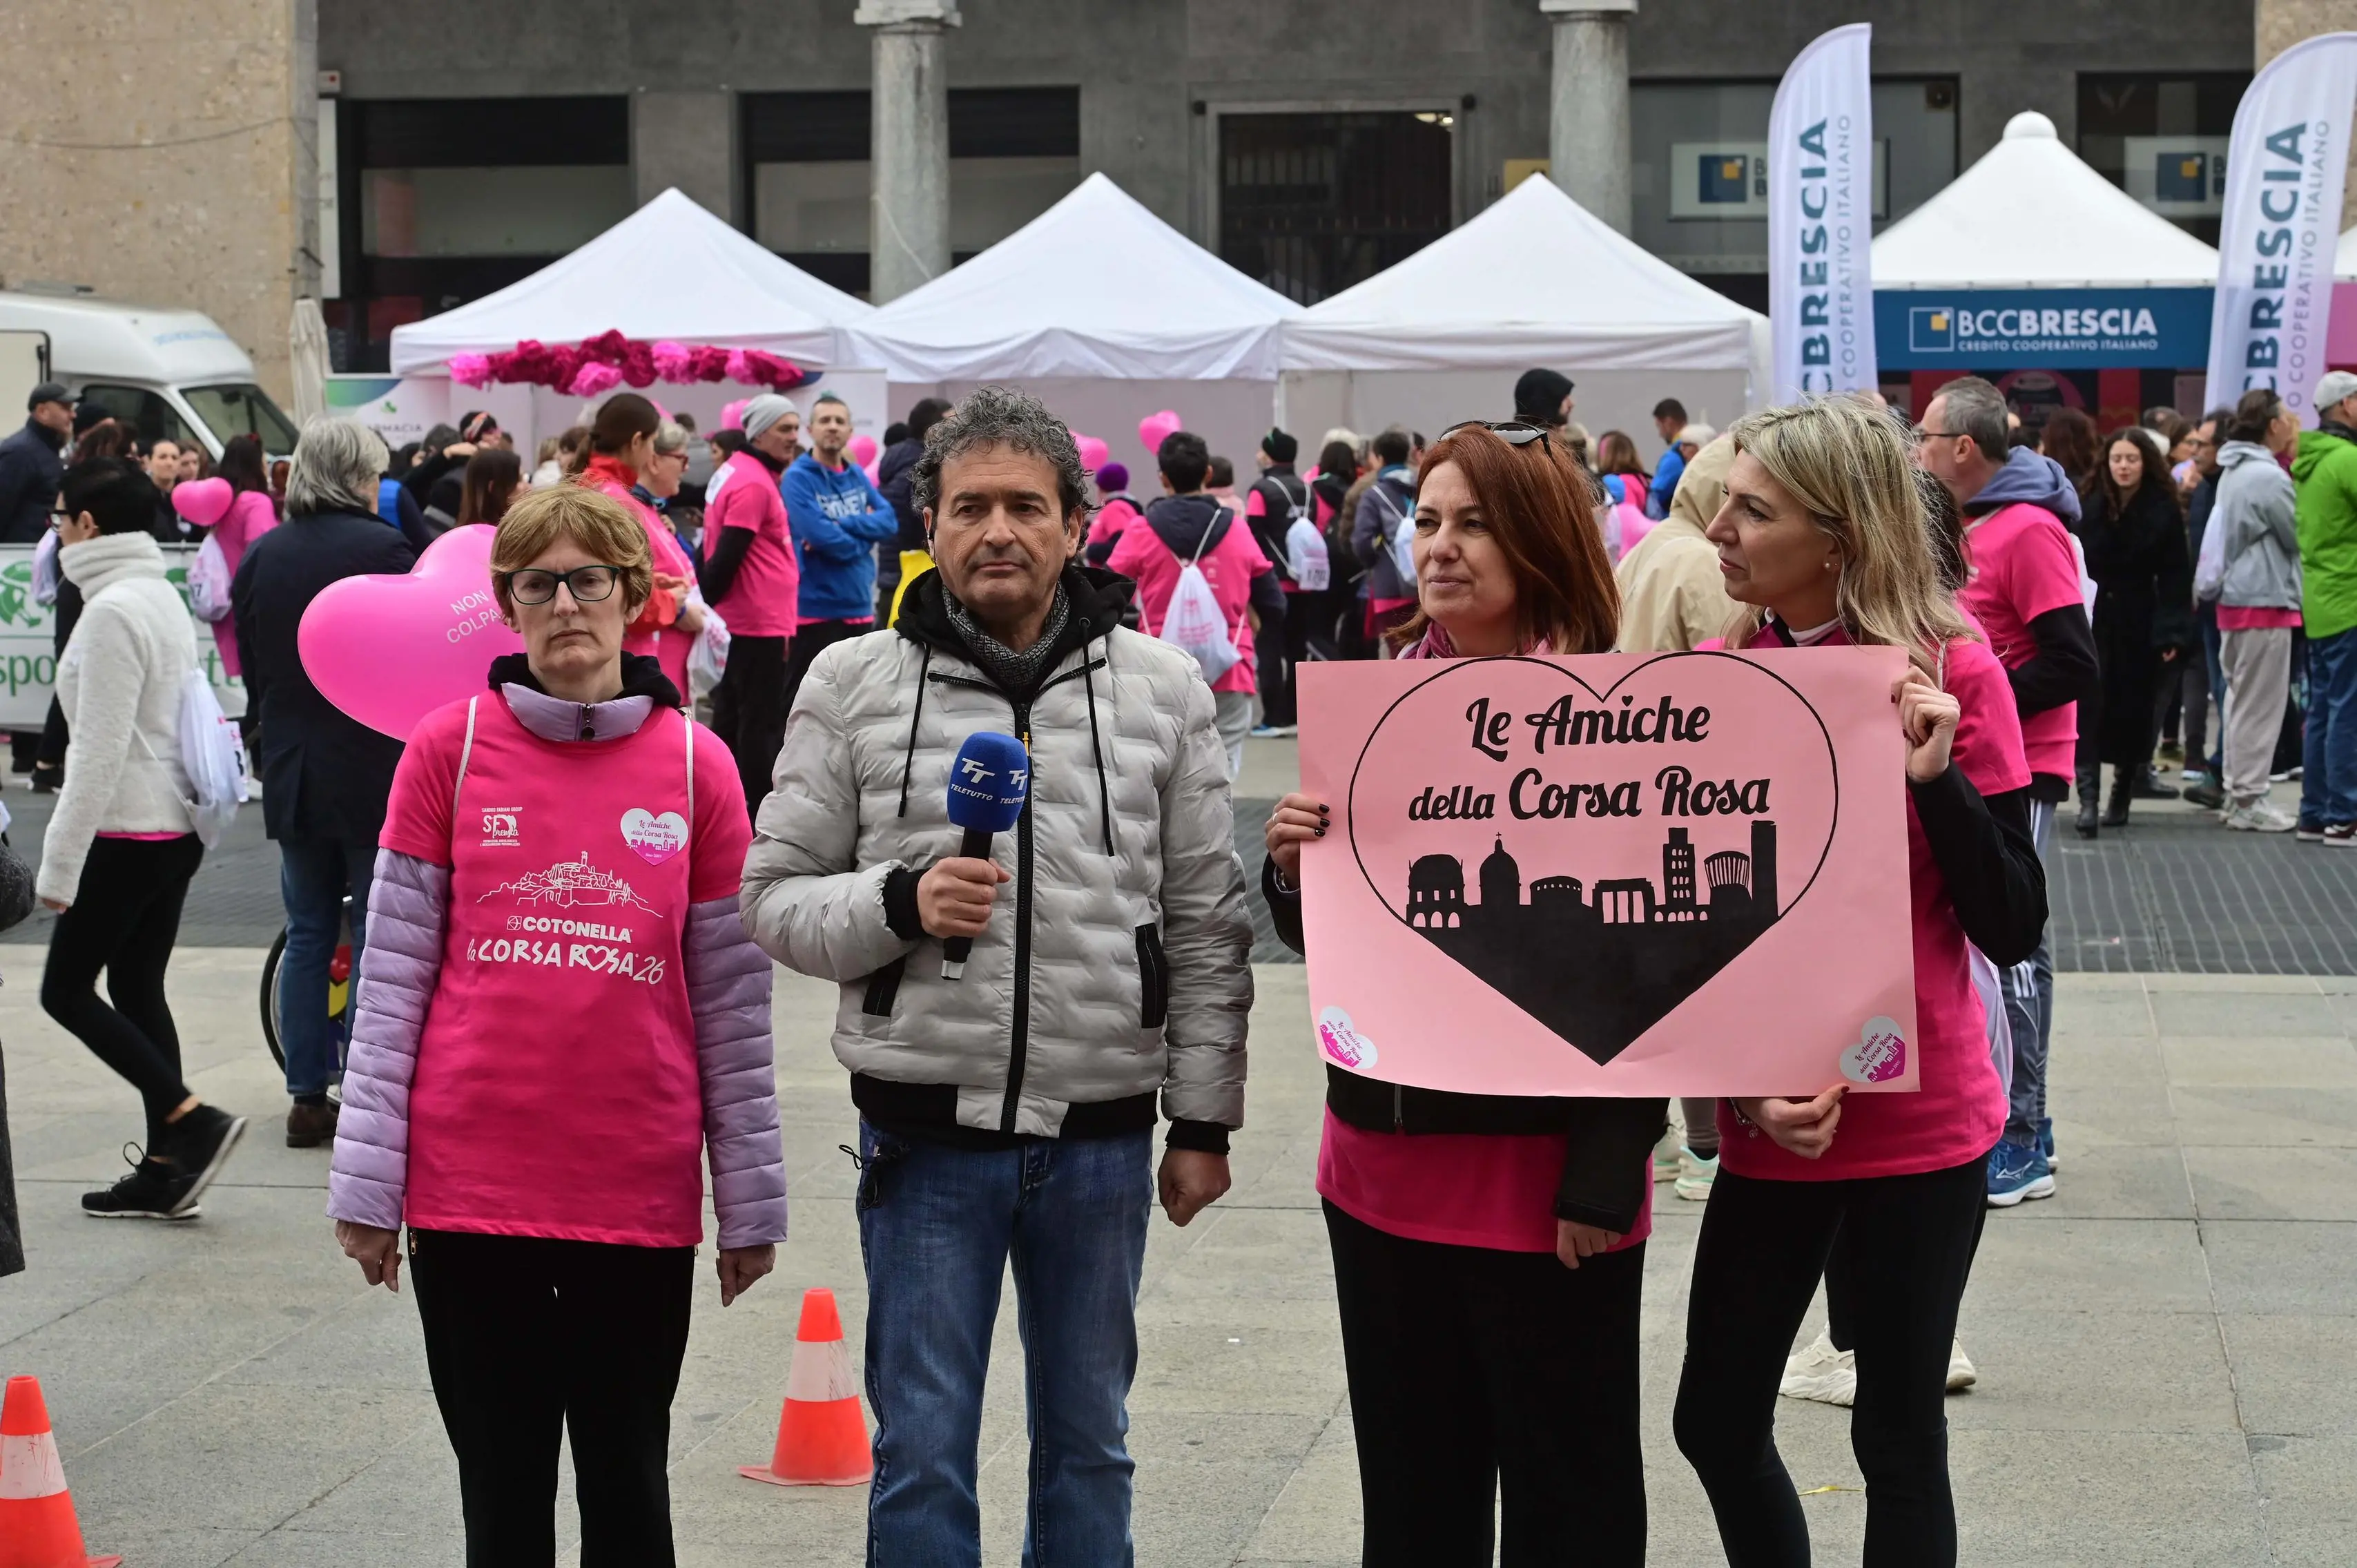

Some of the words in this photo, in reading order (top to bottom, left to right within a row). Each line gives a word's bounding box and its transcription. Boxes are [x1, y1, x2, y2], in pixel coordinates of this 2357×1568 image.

[1837, 115, 1851, 217] ITALIANO
[2288, 231, 2316, 383] COOPERATIVO
[2304, 121, 2329, 222] ITALIANO
[1837, 226, 1856, 378] COOPERATIVO
[1957, 308, 2158, 337] BCCBRESCIA
[1957, 340, 2008, 351] CREDITO
[2012, 339, 2097, 351] COOPERATIVO
[2101, 338, 2158, 351] ITALIANO
[450, 590, 489, 616] NON
[1466, 697, 1511, 762] Le
[1524, 694, 1711, 755] Amiche
[951, 784, 994, 801] TELETUTTO
[1408, 785, 1495, 821] della
[1509, 767, 1642, 820] Corsa
[1654, 765, 1771, 817] Rosa
[639, 820, 646, 829] Le
[647, 821, 672, 829] Amiche
[644, 829, 661, 838] Corsa
[663, 831, 678, 840] Rosa
[523, 916, 633, 943] COTONELLA
[467, 938, 476, 962] la
[478, 938, 561, 967] CORSA
[633, 956, 666, 985] 26
[1337, 1030, 1351, 1047] Corsa
[1861, 1032, 1880, 1055] Amiche
[1867, 1046, 1883, 1063] Corsa
[1879, 1032, 1894, 1048] Rosa
